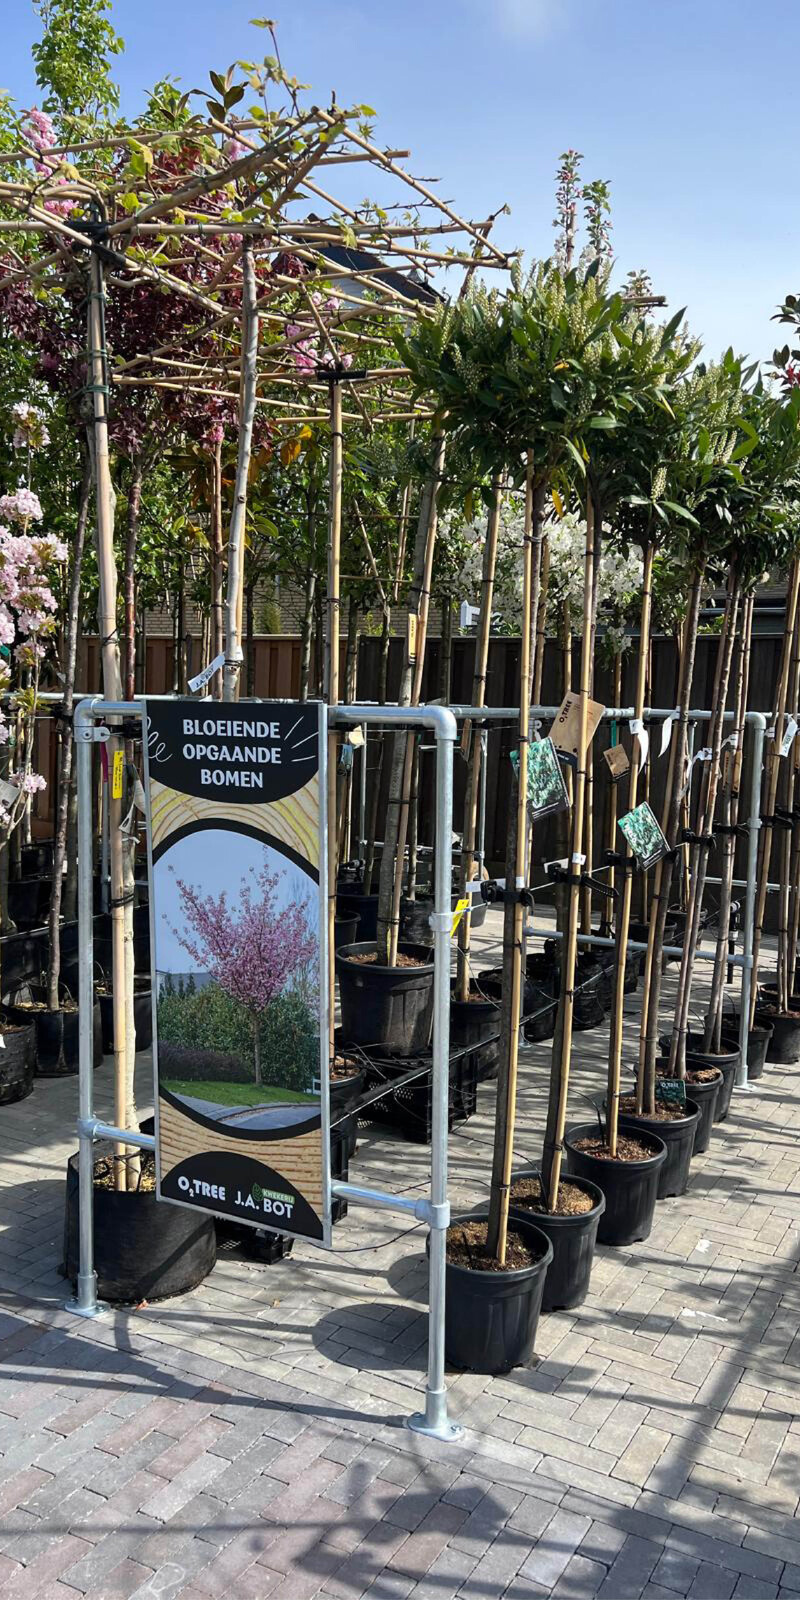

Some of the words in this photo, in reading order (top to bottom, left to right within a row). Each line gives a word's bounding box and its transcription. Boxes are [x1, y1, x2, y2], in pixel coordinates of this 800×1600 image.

[182, 719, 281, 739] BLOEIENDE
[182, 743, 282, 764] OPGAANDE
[200, 768, 263, 788] BOMEN
[234, 1190, 260, 1210] J.A.
[263, 1197, 294, 1219] BOT
